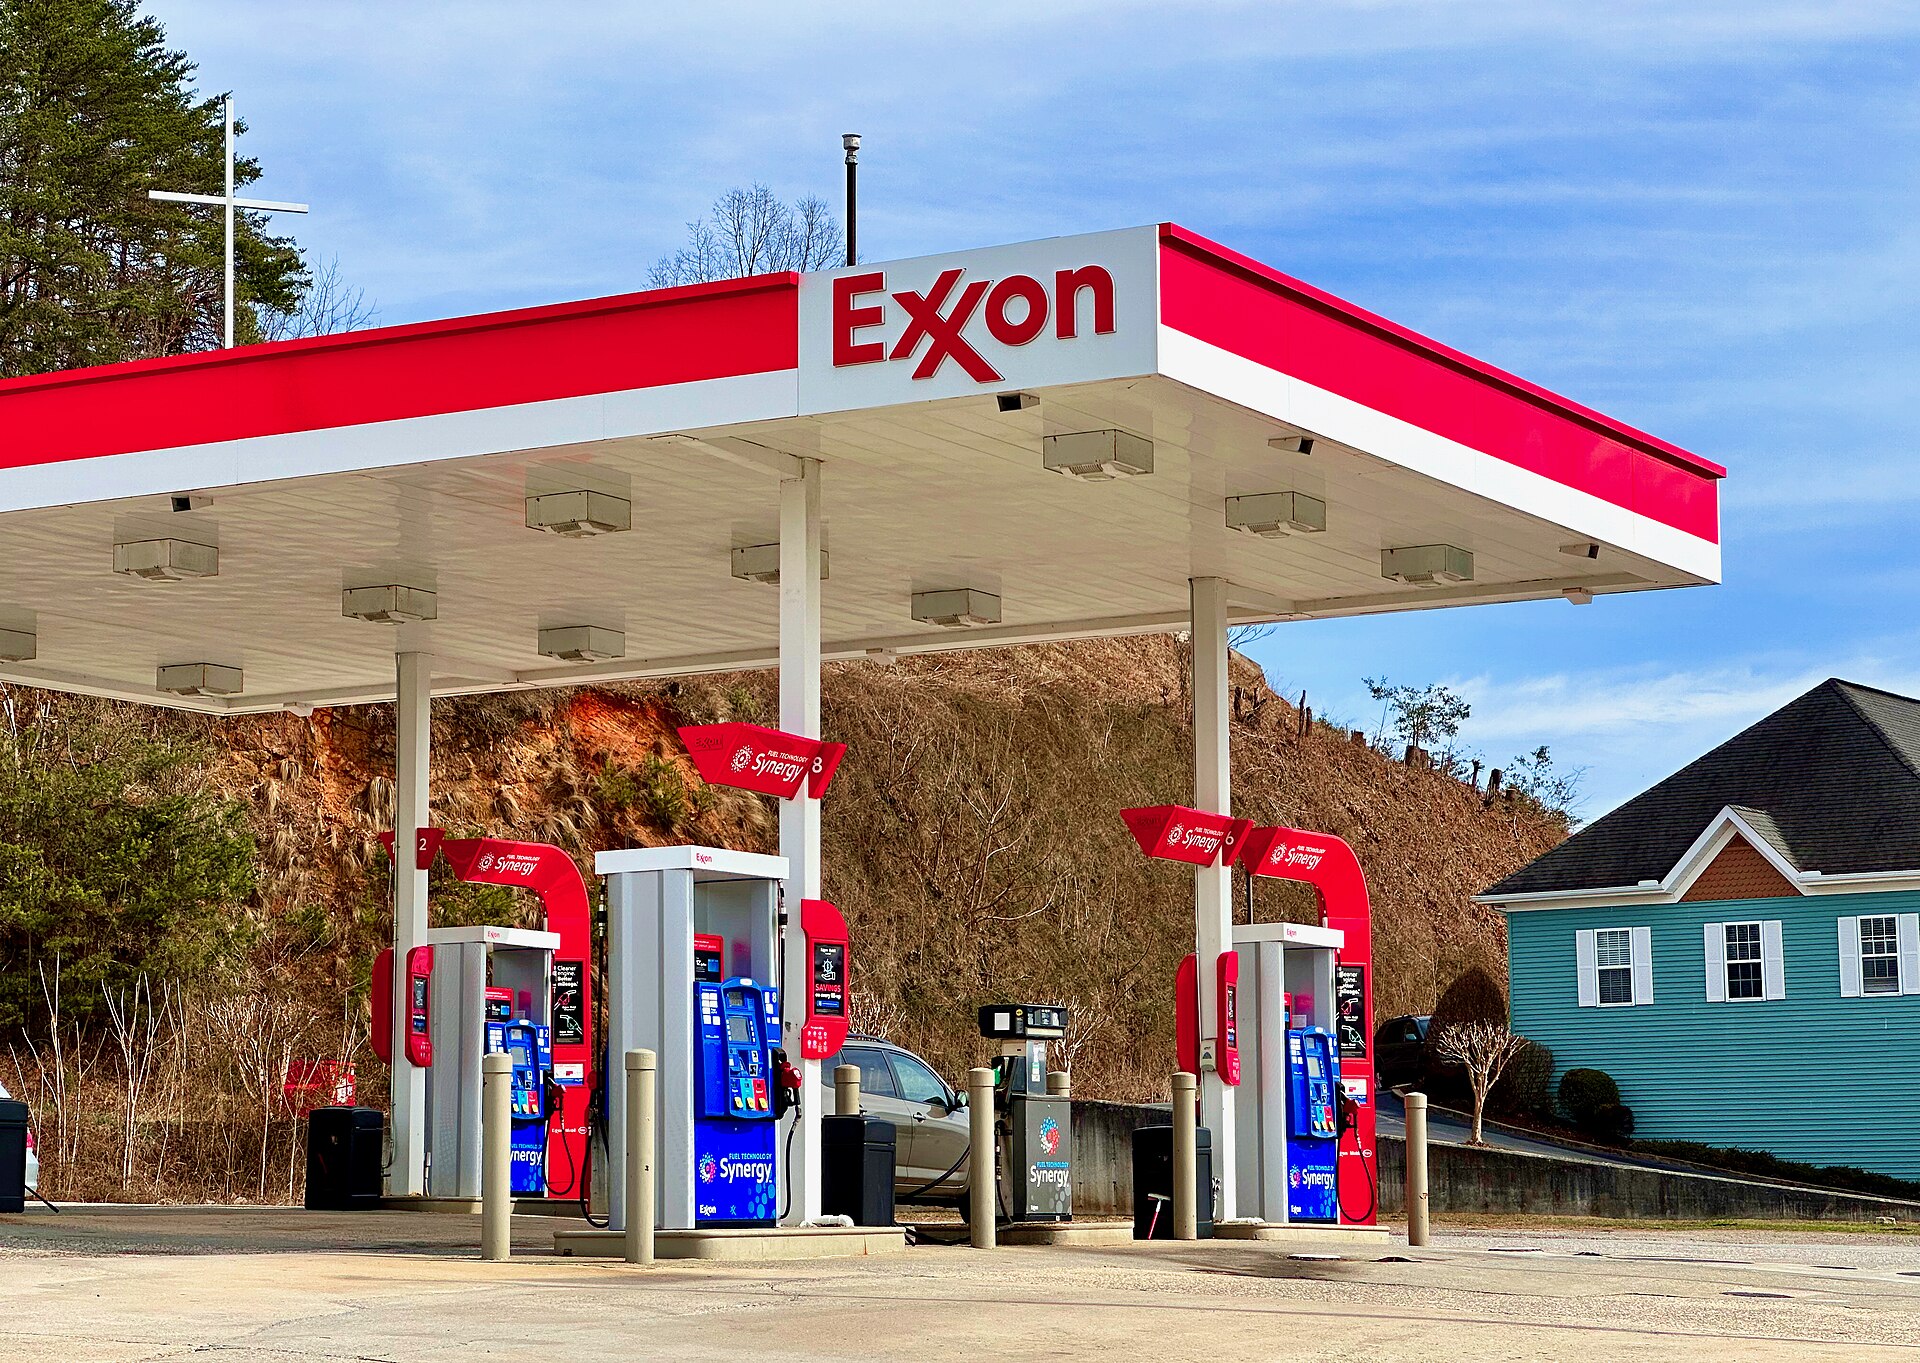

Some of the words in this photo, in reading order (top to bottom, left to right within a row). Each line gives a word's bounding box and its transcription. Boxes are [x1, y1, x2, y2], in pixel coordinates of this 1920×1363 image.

[832, 264, 1116, 383] Exxon
[694, 735, 723, 751] Exxon
[767, 750, 779, 758] FUEL
[779, 751, 809, 763] TECHNOLOGY
[751, 753, 804, 782] Synergy
[811, 756, 823, 774] 8
[419, 838, 427, 850] 2
[1182, 831, 1221, 854] Synergy
[1225, 832, 1235, 845] 6
[695, 852, 713, 864] Exxon
[1284, 848, 1323, 870] Synergy
[494, 857, 538, 876] Synergy
[487, 930, 500, 939] Exxon
[815, 983, 841, 992] SAVINGS
[772, 992, 777, 1003] 8
[545, 1029, 549, 1037] 2
[720, 1157, 772, 1183] Synergy
[1030, 1165, 1069, 1187] Synergy
[1302, 1168, 1334, 1189] Synergy
[700, 1204, 716, 1216] Exxon
